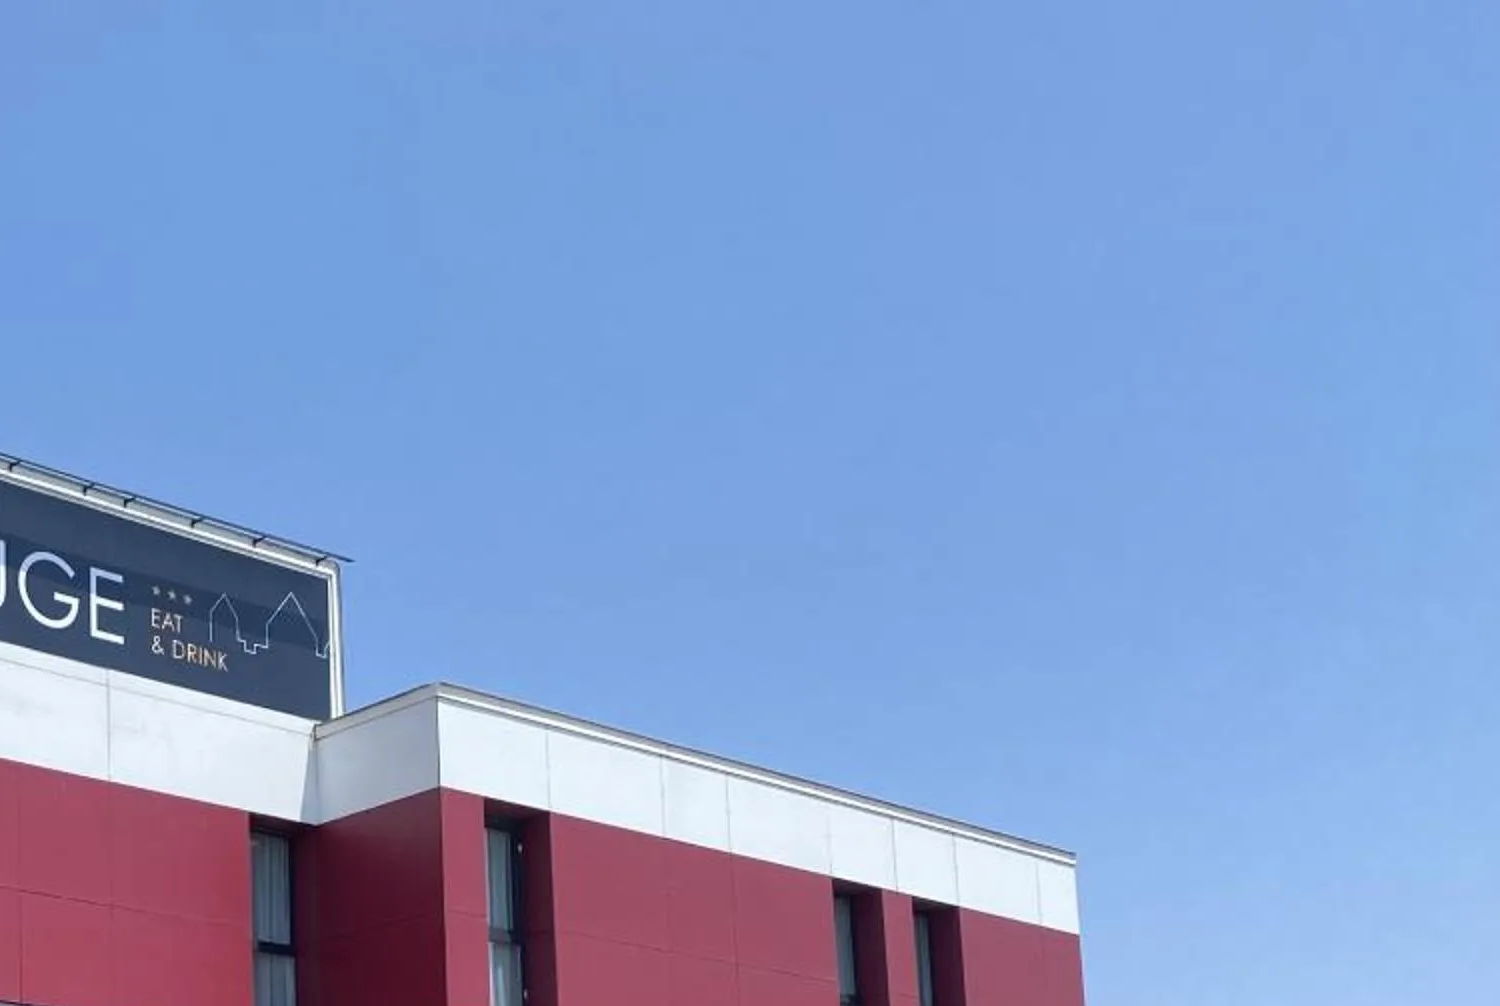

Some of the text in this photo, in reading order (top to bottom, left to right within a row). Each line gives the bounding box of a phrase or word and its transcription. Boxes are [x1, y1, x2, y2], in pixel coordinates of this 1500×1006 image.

[150, 607, 183, 633] EAT
[150, 635, 229, 672] & DRINK
